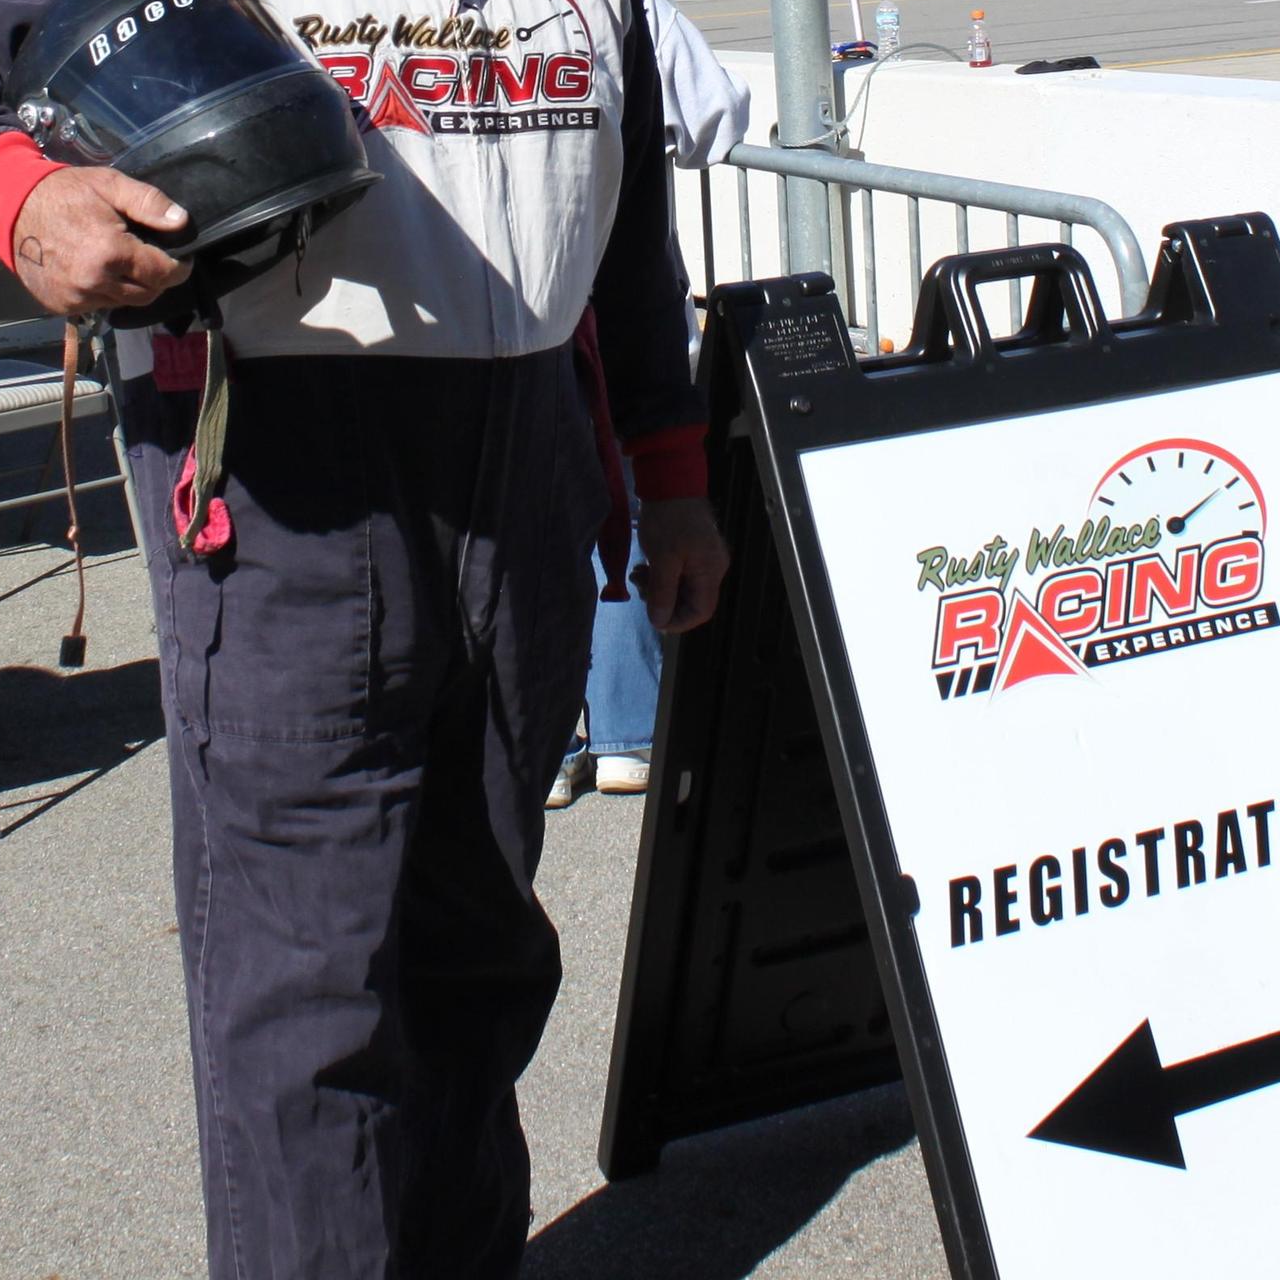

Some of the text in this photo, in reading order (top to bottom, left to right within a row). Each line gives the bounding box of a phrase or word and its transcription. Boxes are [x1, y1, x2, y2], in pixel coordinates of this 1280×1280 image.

[293, 12, 388, 57] Rusty
[318, 51, 595, 120] RACING
[916, 514, 1162, 593] Rusty Wallace
[931, 535, 1266, 680] RACING
[1094, 607, 1271, 663] EXPERIENCE
